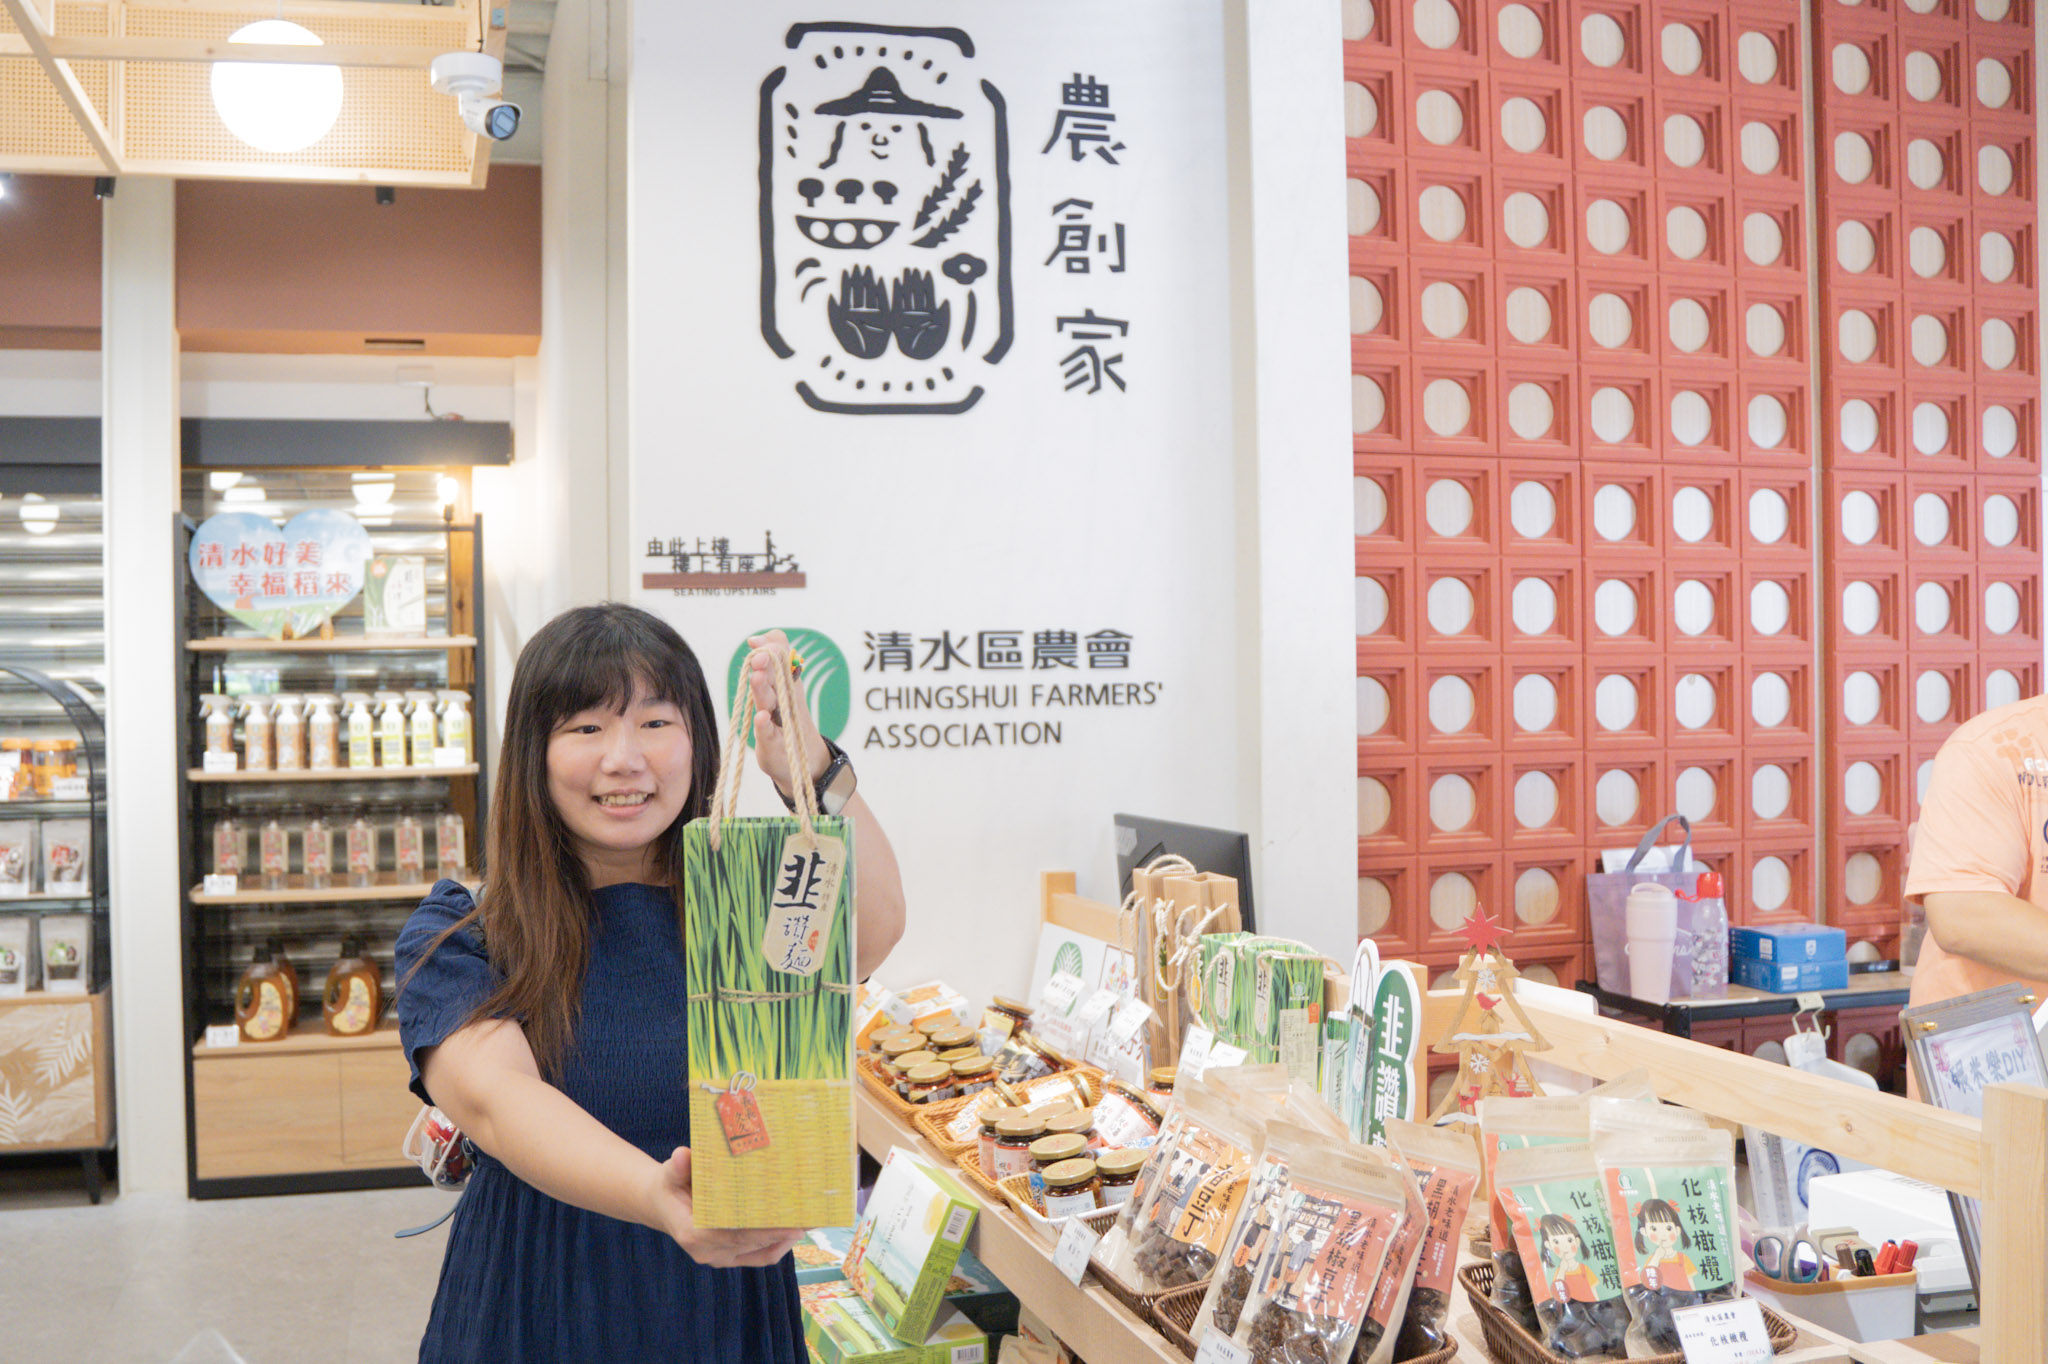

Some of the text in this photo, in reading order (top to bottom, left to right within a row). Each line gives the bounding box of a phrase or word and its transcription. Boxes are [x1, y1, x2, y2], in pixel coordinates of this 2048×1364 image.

[1041, 72, 1129, 395] 農創家
[198, 540, 322, 568] 清水好美
[647, 537, 730, 556] 由此上樓
[672, 553, 755, 573] 樓上有座
[228, 570, 352, 597] 幸福稻來
[673, 586, 777, 597] SEATING UPSTAIRS
[863, 628, 1134, 672] 清水區農會
[864, 682, 1164, 711] CHINGSHUI FARMERS'
[864, 721, 1063, 749] ASSOCIATION
[1570, 1190, 1621, 1290] 化核橄欖
[1681, 1178, 1723, 1281] 化核橄欖
